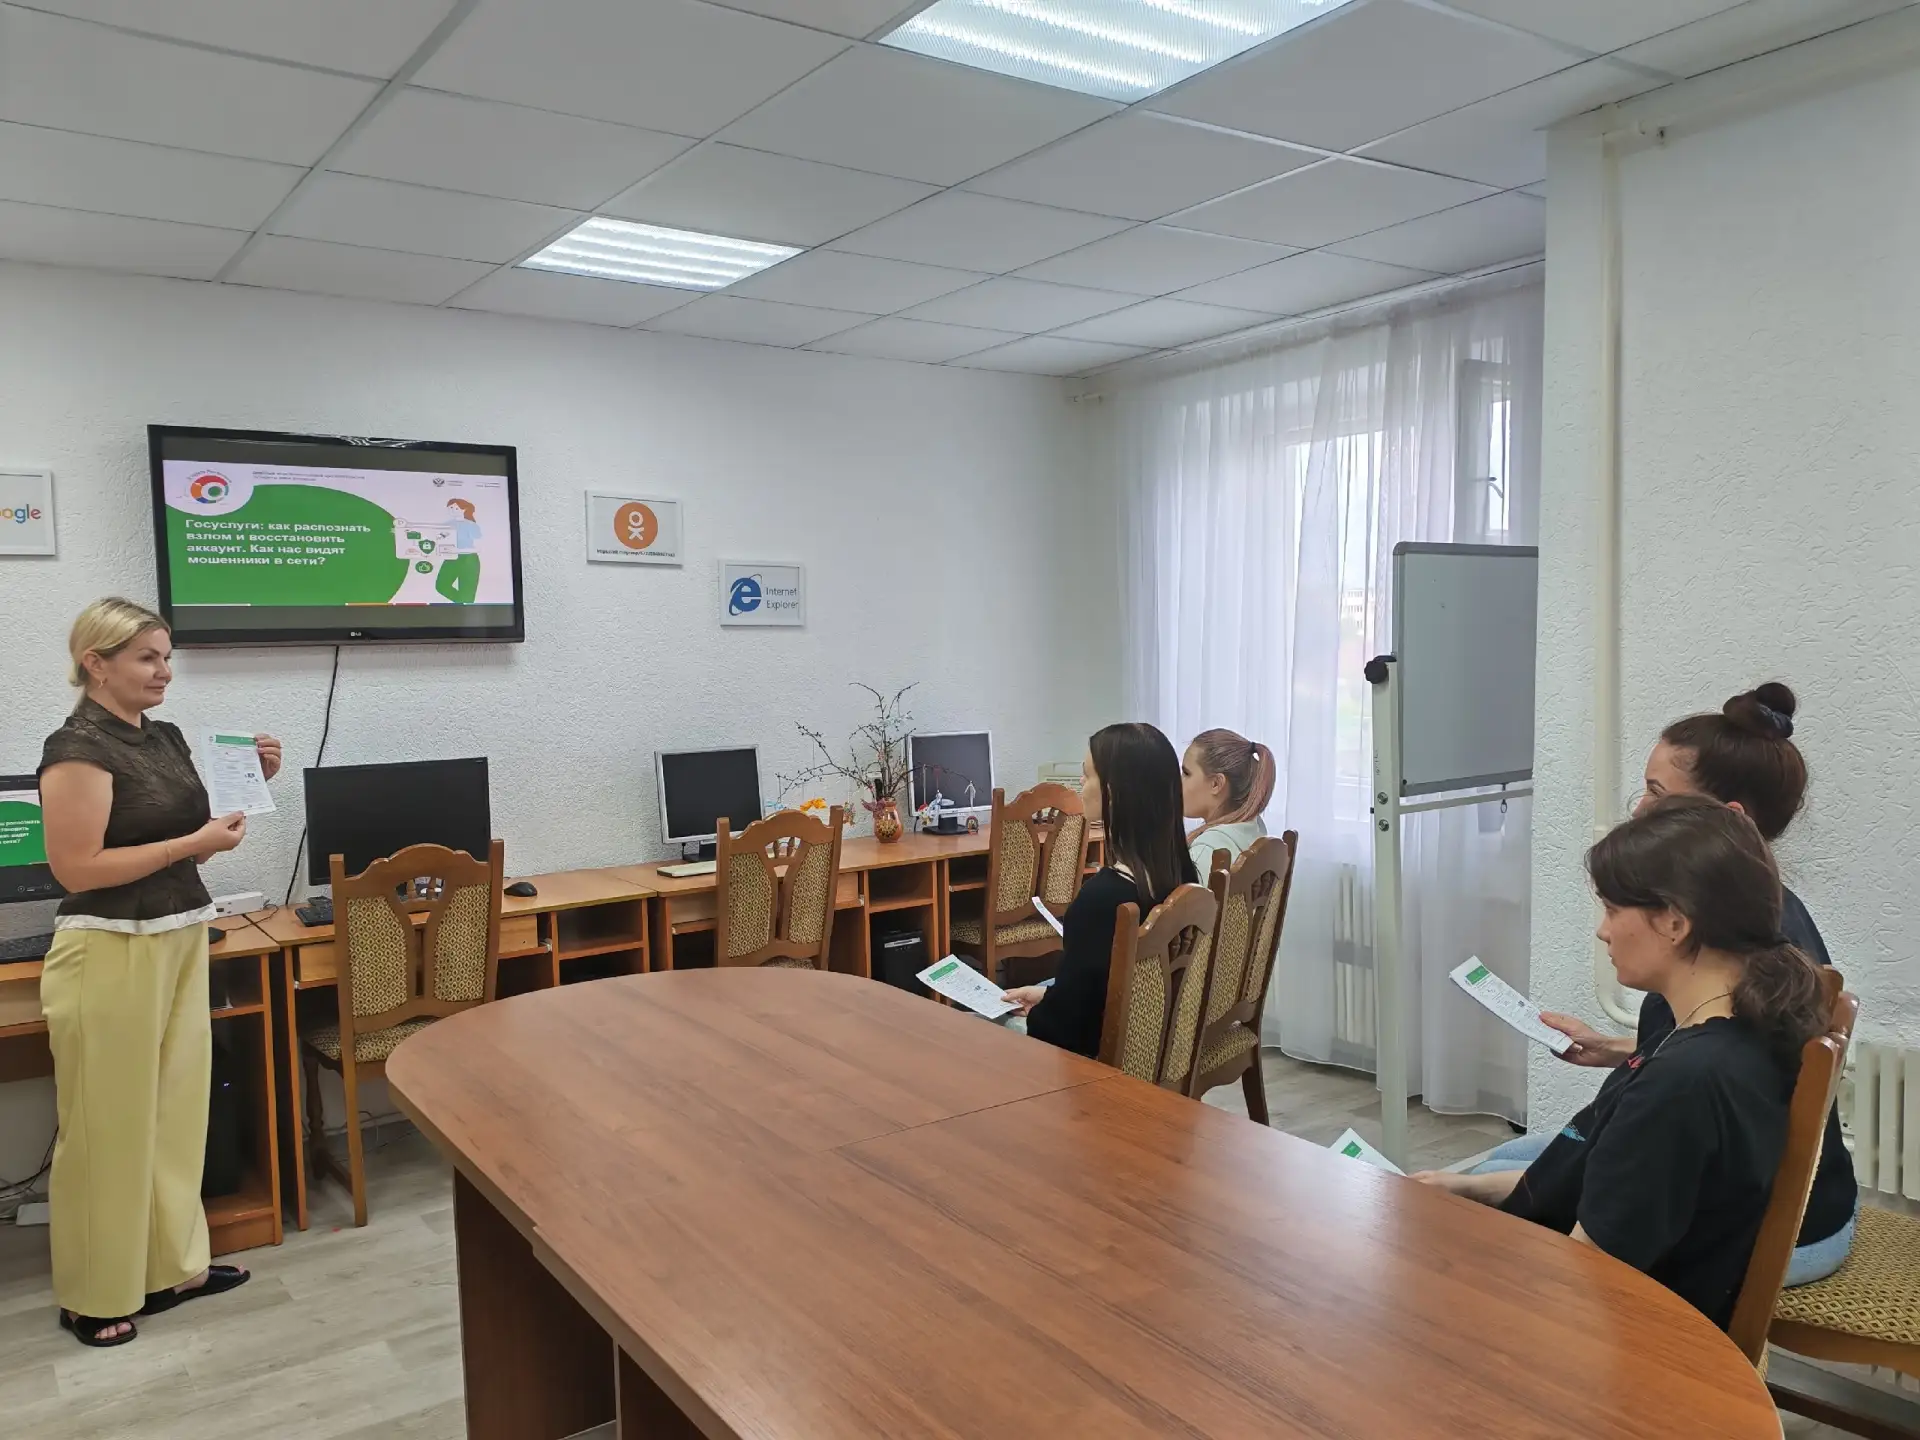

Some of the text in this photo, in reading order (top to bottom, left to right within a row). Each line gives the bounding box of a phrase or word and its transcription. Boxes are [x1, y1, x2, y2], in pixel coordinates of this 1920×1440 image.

[0, 503, 42, 524] ogle
[185, 519, 371, 533] Госуслуги: как распознать
[186, 533, 345, 543] взлом и восстановить
[186, 545, 346, 555] аккаунт. Как нас видят
[187, 556, 326, 566] мошенники в сети?
[765, 587, 797, 596] Internet
[766, 600, 799, 611] Explorer
